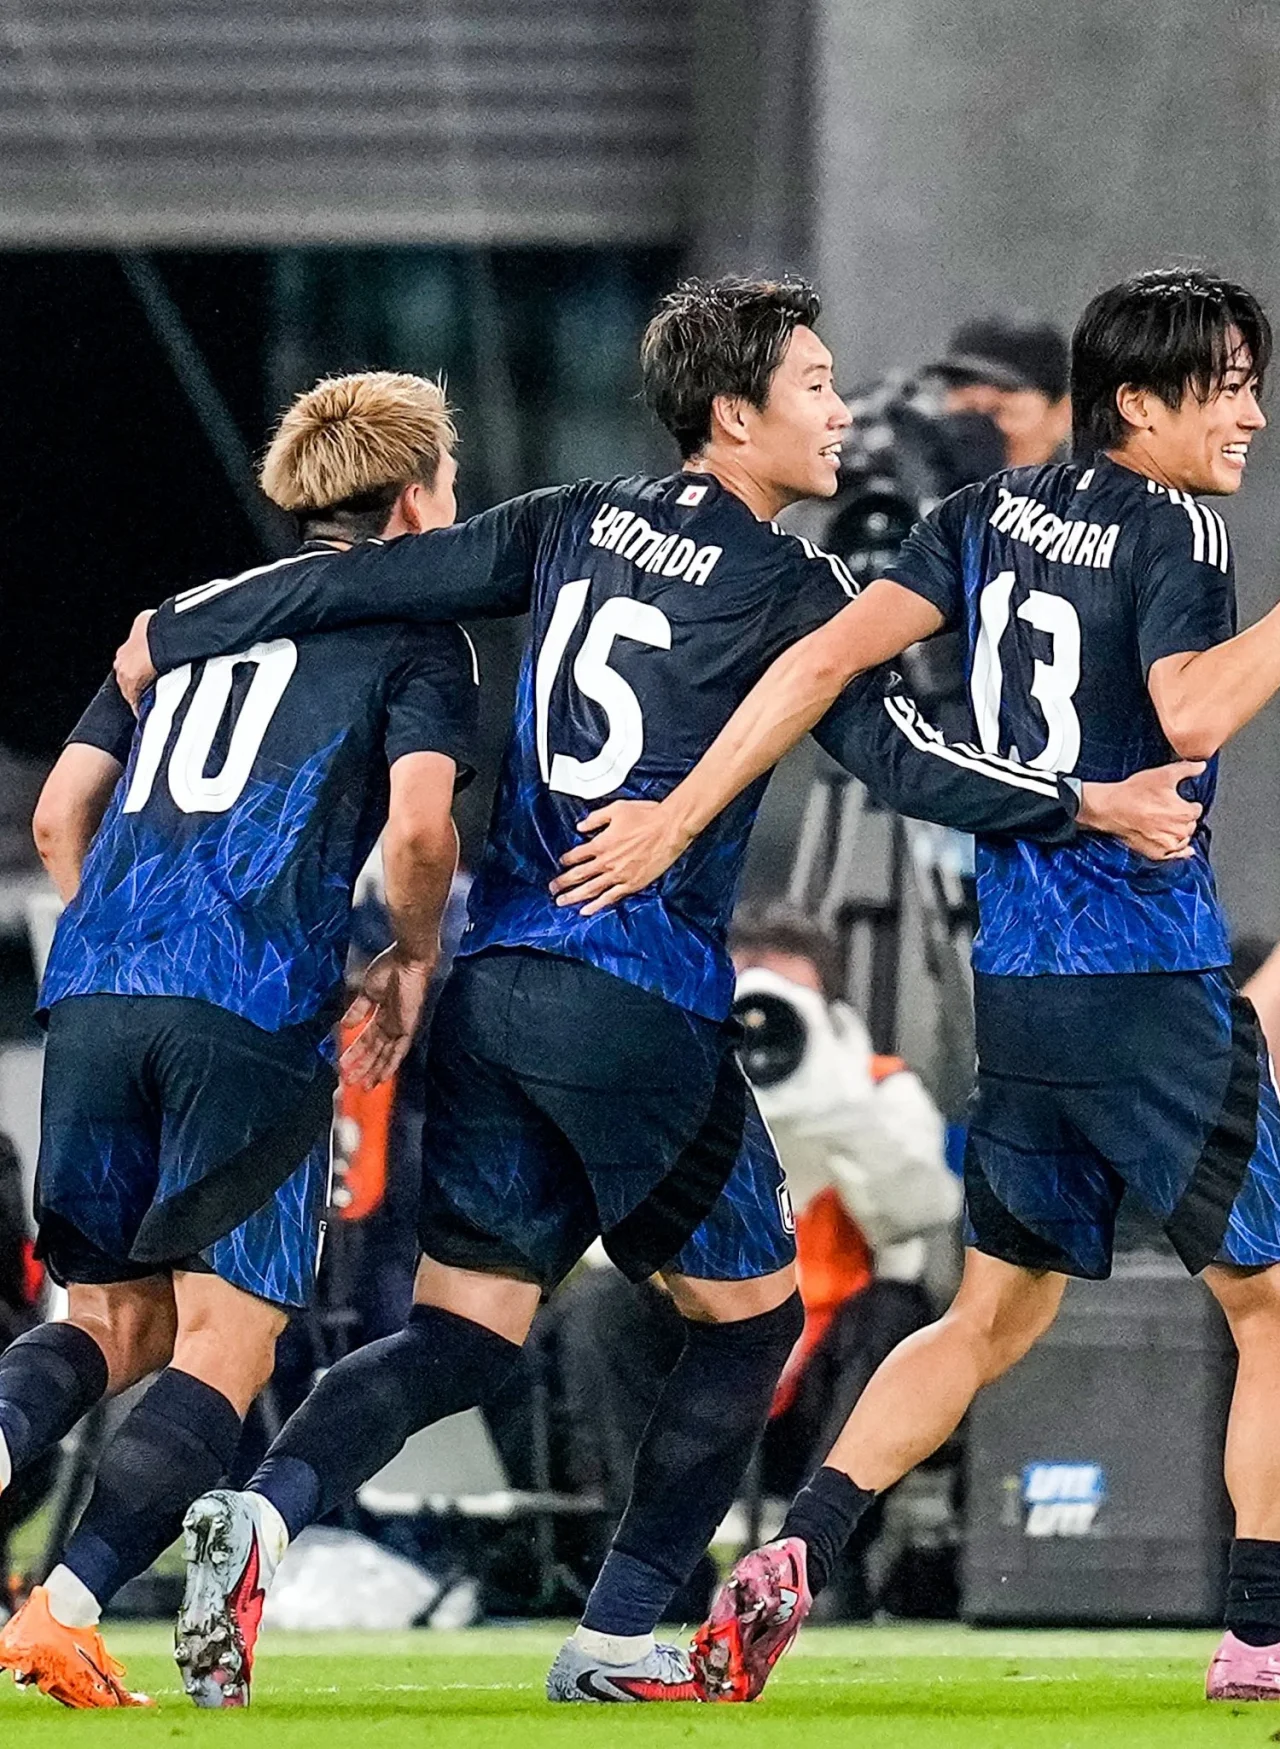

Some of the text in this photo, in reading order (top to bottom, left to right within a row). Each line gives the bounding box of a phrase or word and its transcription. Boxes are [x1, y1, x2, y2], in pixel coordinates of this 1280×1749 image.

[589, 502, 723, 586] YAMADA
[122, 638, 298, 814] 10
[536, 578, 672, 800] 15
[971, 570, 1081, 773] 13
